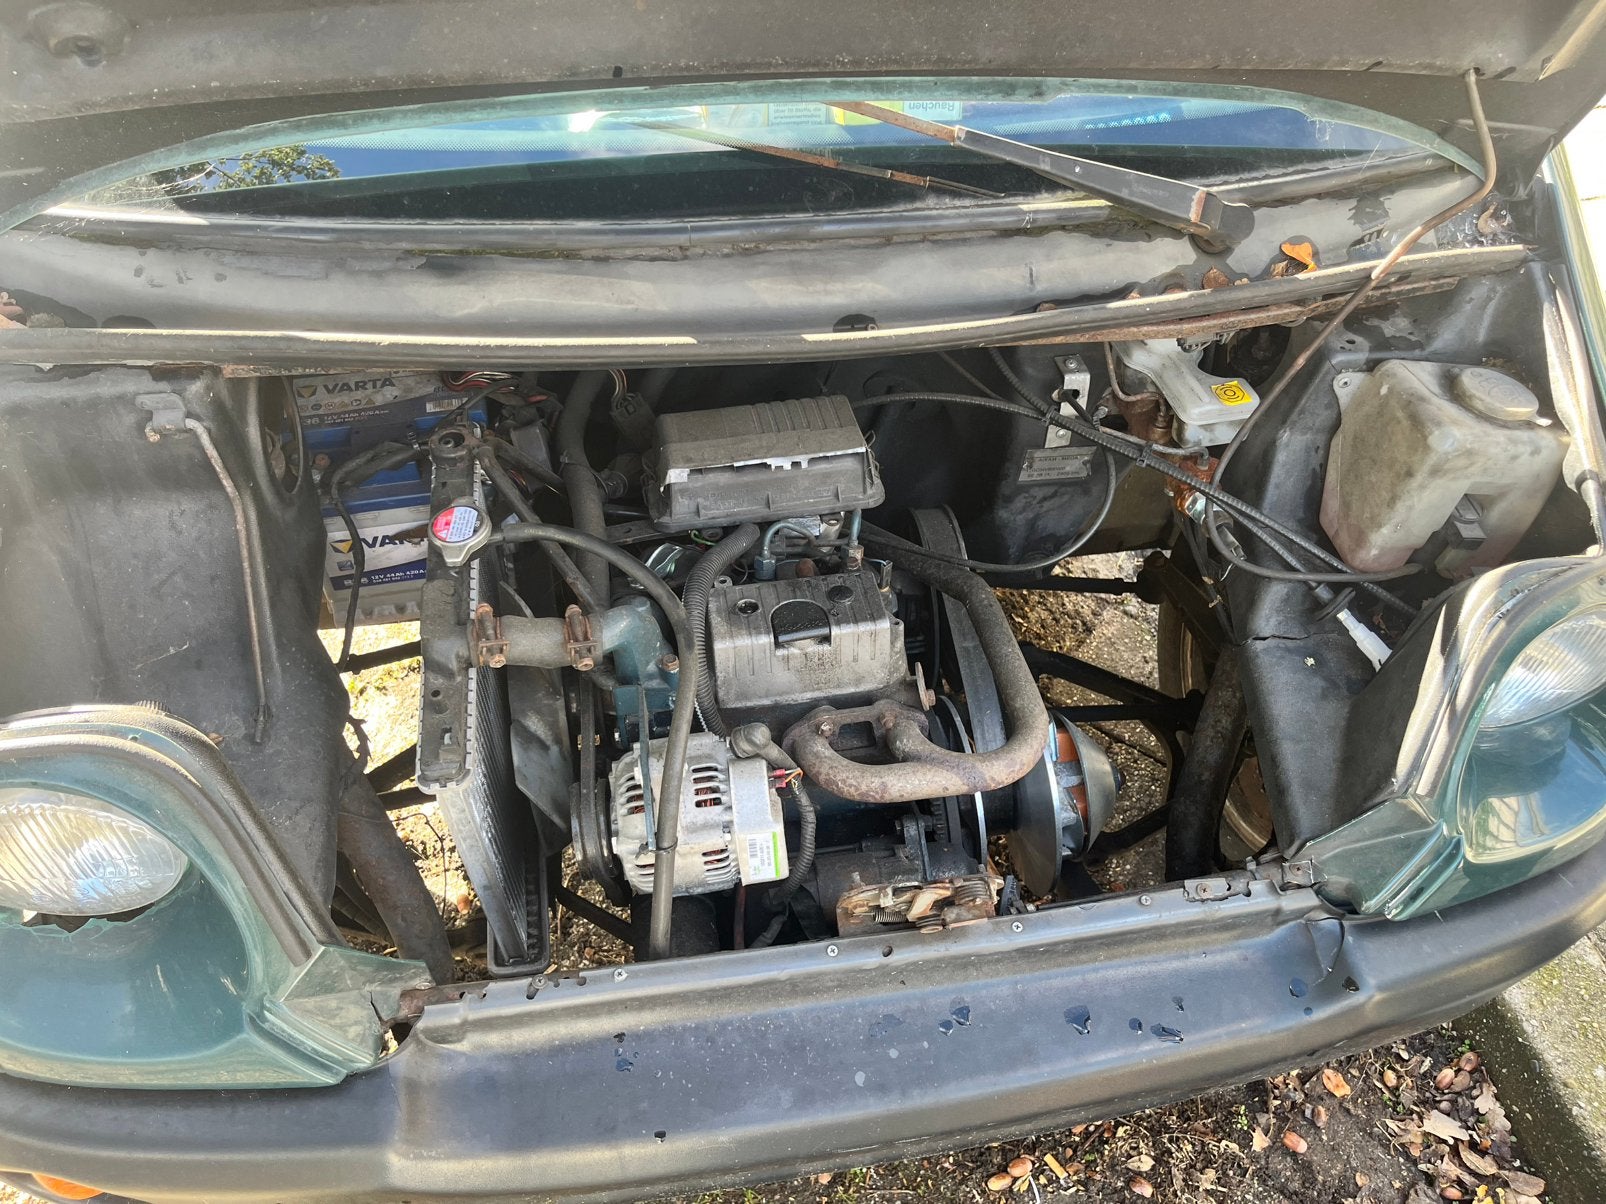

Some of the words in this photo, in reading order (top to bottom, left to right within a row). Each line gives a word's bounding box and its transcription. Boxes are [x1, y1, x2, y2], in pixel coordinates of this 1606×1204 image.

[908, 101, 955, 112] Rauchen
[323, 378, 396, 394] VARTA
[344, 577, 369, 587] B6
